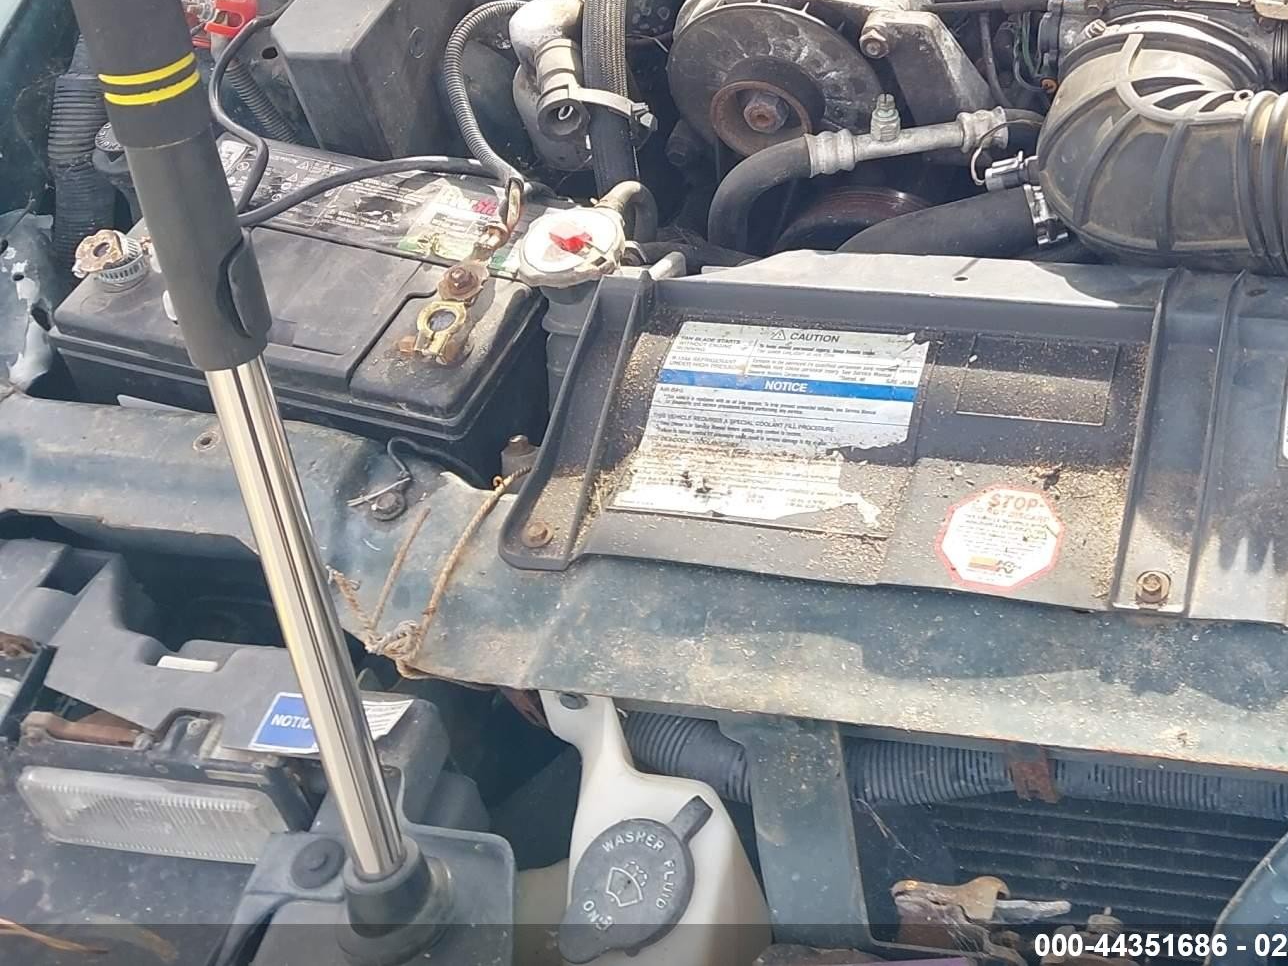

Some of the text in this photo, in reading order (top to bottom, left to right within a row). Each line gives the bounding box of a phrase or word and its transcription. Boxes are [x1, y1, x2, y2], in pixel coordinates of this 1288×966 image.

[790, 332, 840, 343] CAUTION
[765, 380, 808, 392] NOTICE
[755, 420, 784, 428] COOLANT
[987, 493, 1039, 511] STOP
[270, 713, 313, 730] NOTIC
[601, 830, 665, 853] WASHER
[655, 859, 676, 910] FLUID
